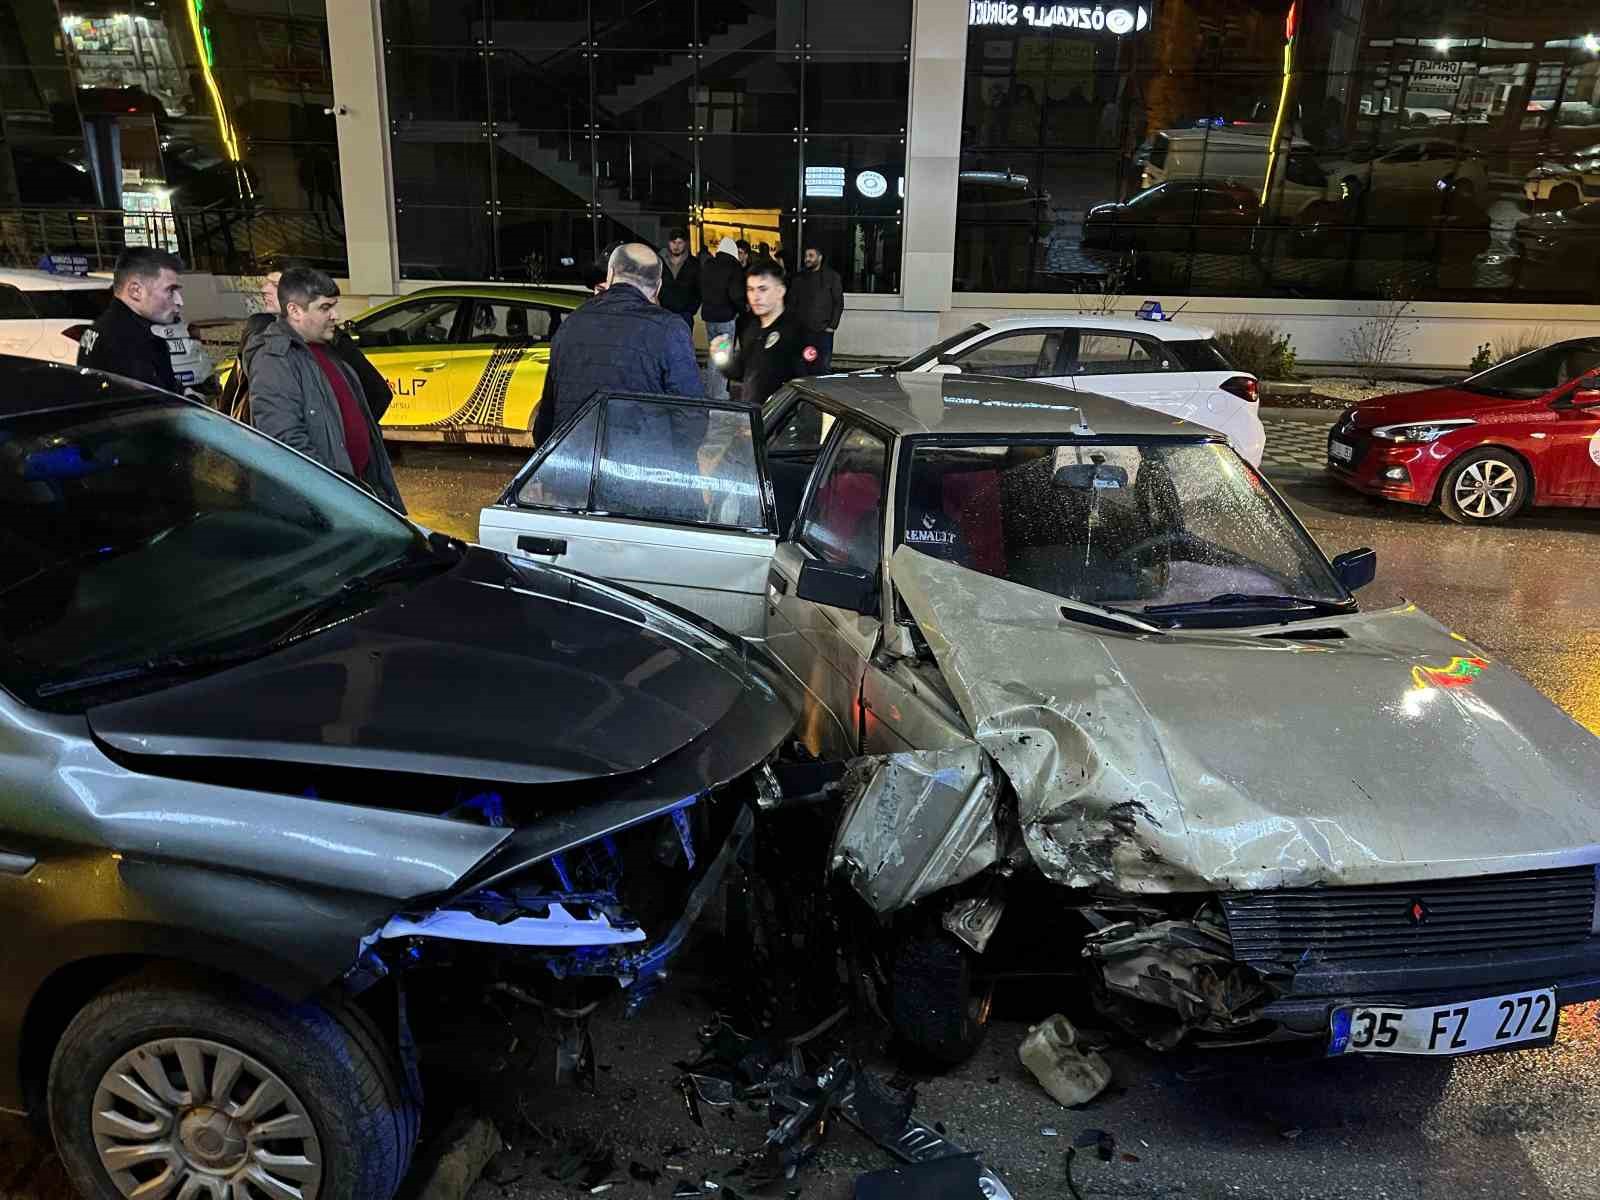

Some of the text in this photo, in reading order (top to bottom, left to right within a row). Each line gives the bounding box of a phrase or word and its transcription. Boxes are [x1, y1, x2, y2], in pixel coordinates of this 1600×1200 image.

[1352, 1010, 1403, 1048] 35
[1428, 1007, 1469, 1050] FZ
[1495, 994, 1551, 1040] 272
